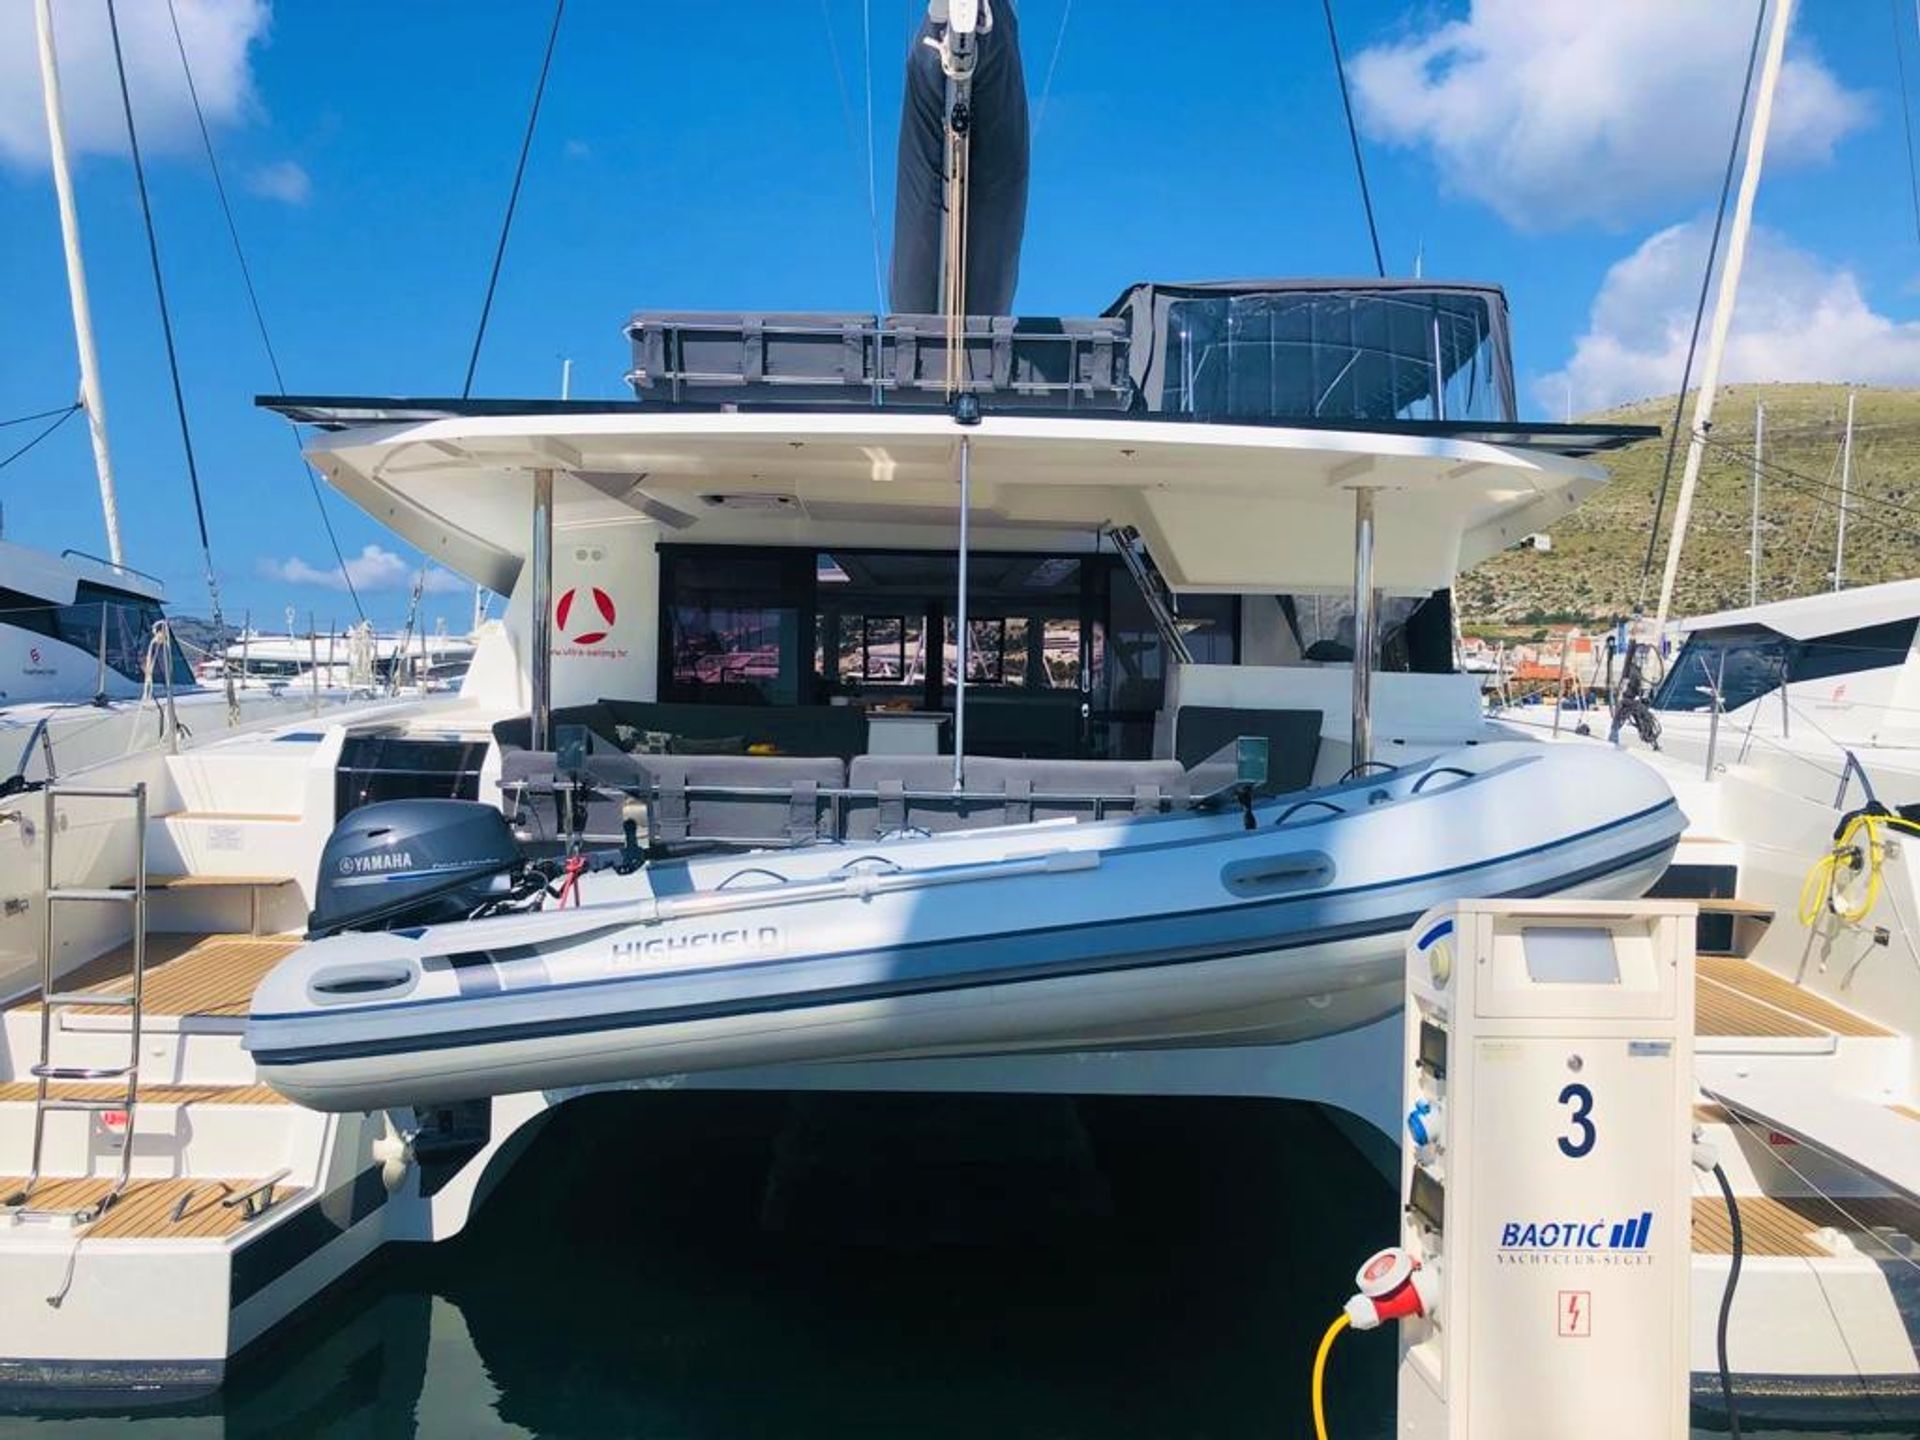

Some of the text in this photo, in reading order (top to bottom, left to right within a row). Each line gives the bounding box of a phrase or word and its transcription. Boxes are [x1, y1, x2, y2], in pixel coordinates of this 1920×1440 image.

[354, 853, 412, 871] YAMAHA
[612, 926, 779, 963] HIGHFIELD
[1557, 1083, 1597, 1159] 3
[1501, 1218, 1605, 1248] BAOTIĆ
